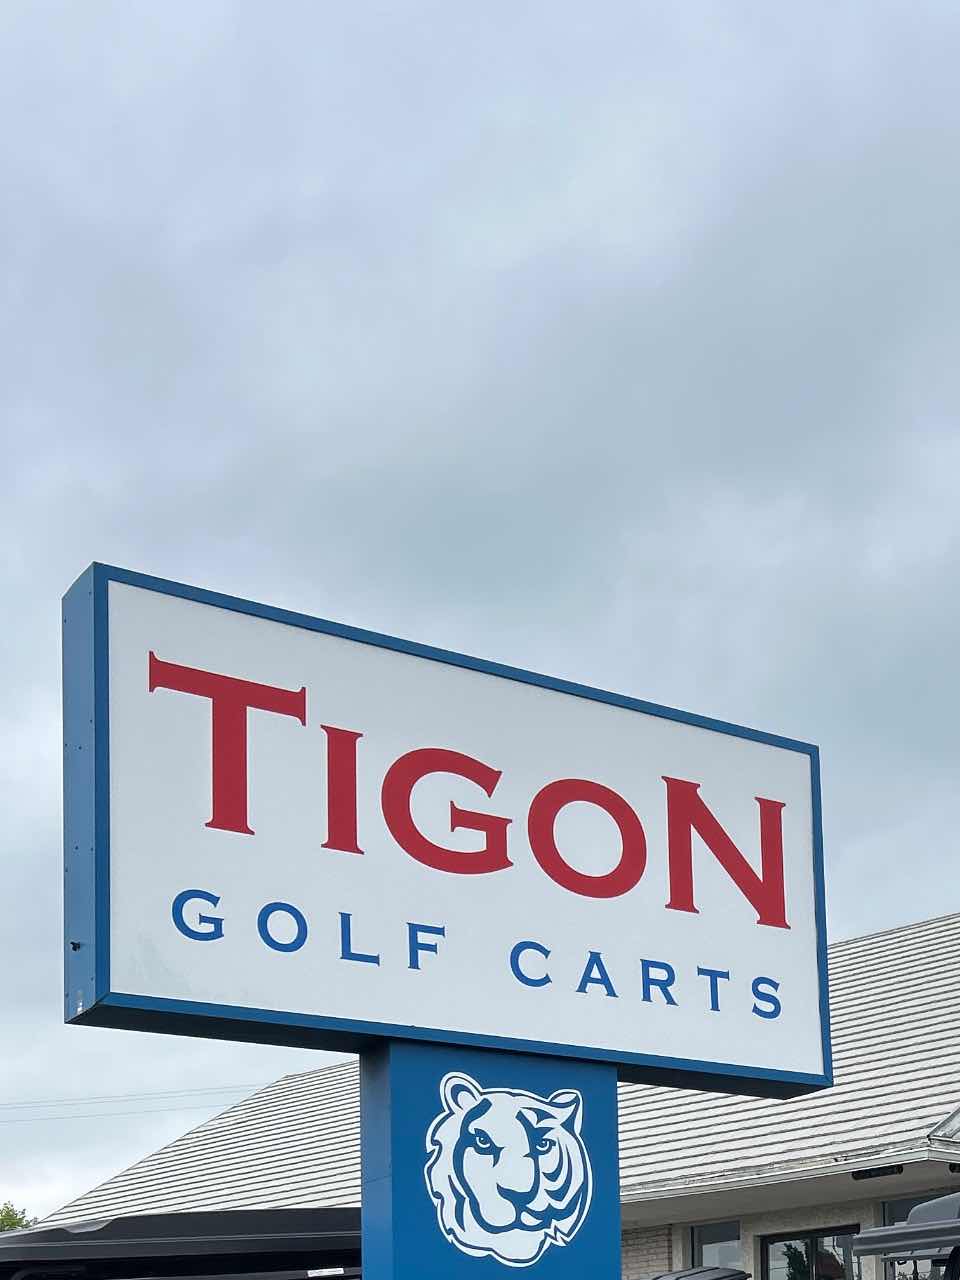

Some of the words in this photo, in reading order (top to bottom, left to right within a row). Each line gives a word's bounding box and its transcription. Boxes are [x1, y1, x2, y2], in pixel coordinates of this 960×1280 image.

[148, 650, 791, 929] TIGON
[171, 888, 447, 970] GOLF
[509, 940, 782, 1019] CARTS
